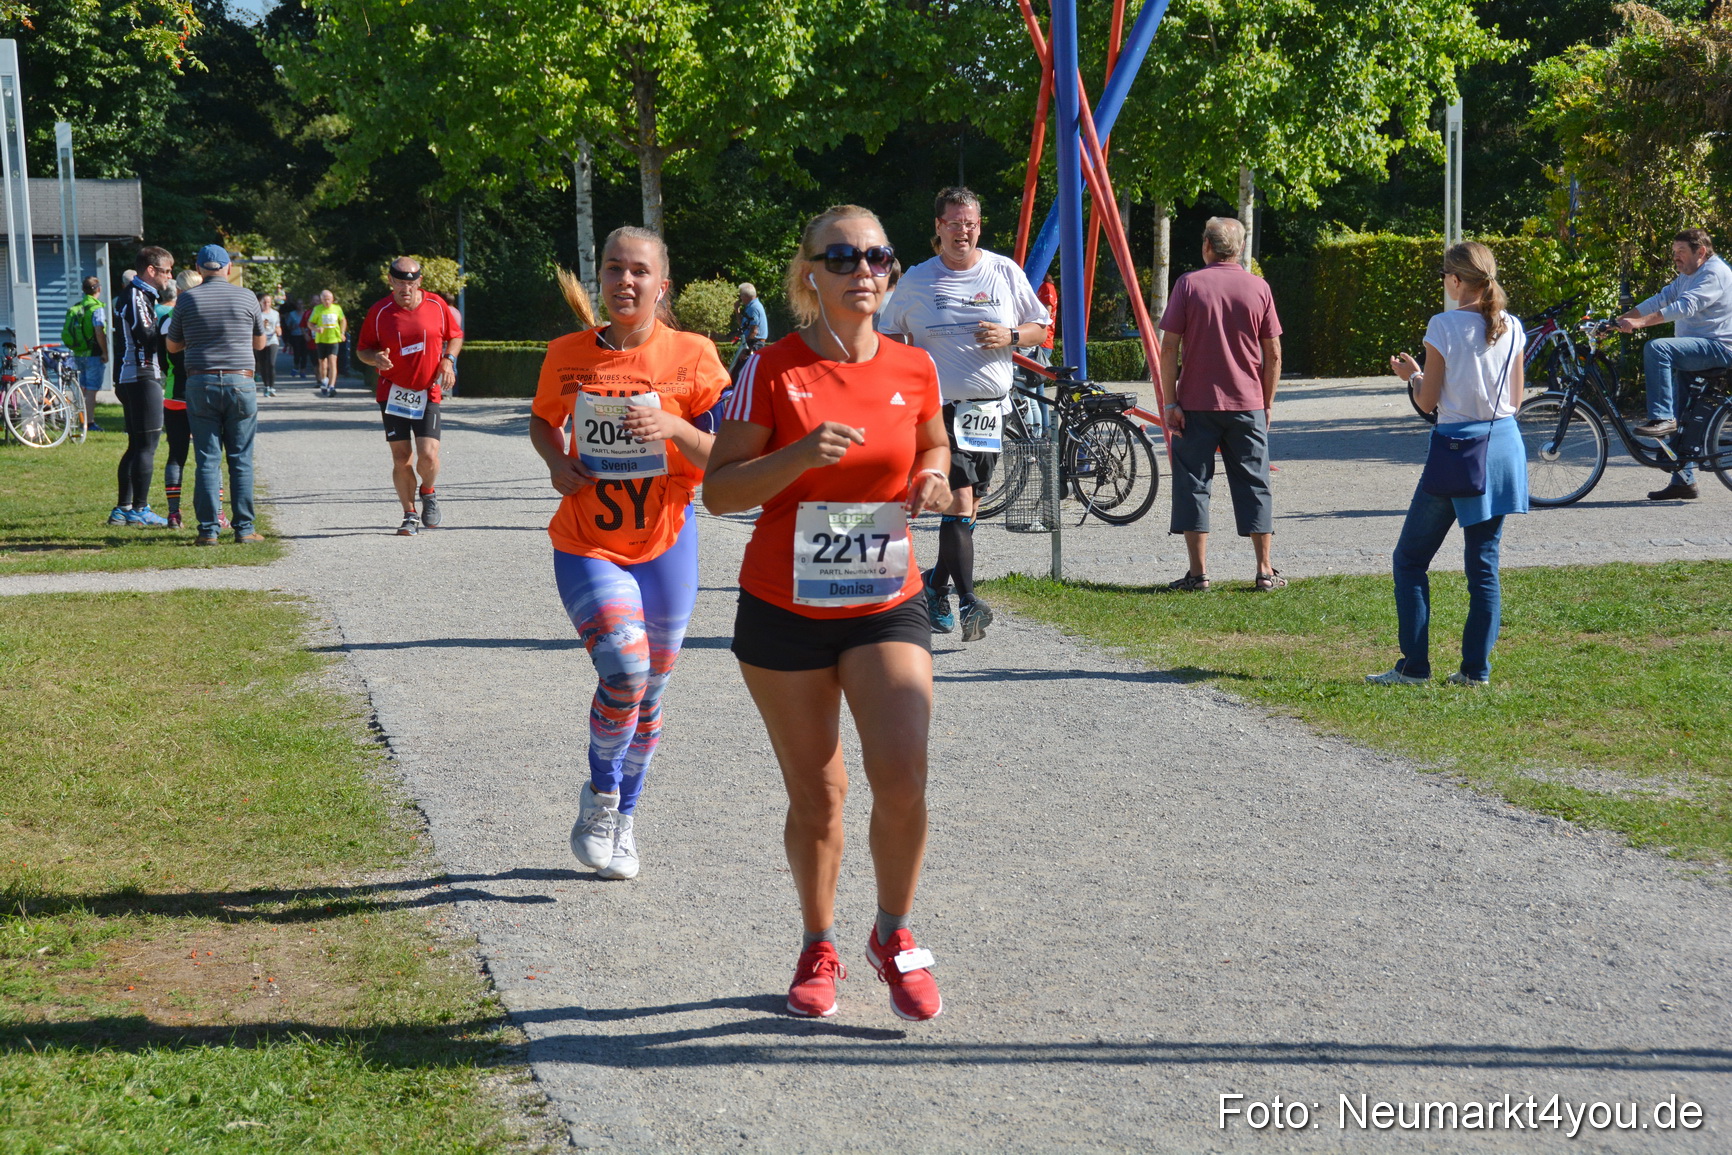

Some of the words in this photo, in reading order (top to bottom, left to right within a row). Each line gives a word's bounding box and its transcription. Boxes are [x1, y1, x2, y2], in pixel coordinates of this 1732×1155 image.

[660, 386, 688, 394] SPEED
[394, 390, 421, 405] 2434
[962, 414, 996, 430] 2104
[584, 418, 646, 446] 204
[601, 460, 638, 472] Svenja
[828, 512, 876, 524] BOCK
[812, 532, 890, 564] 2217
[829, 582, 874, 596] Denisa
